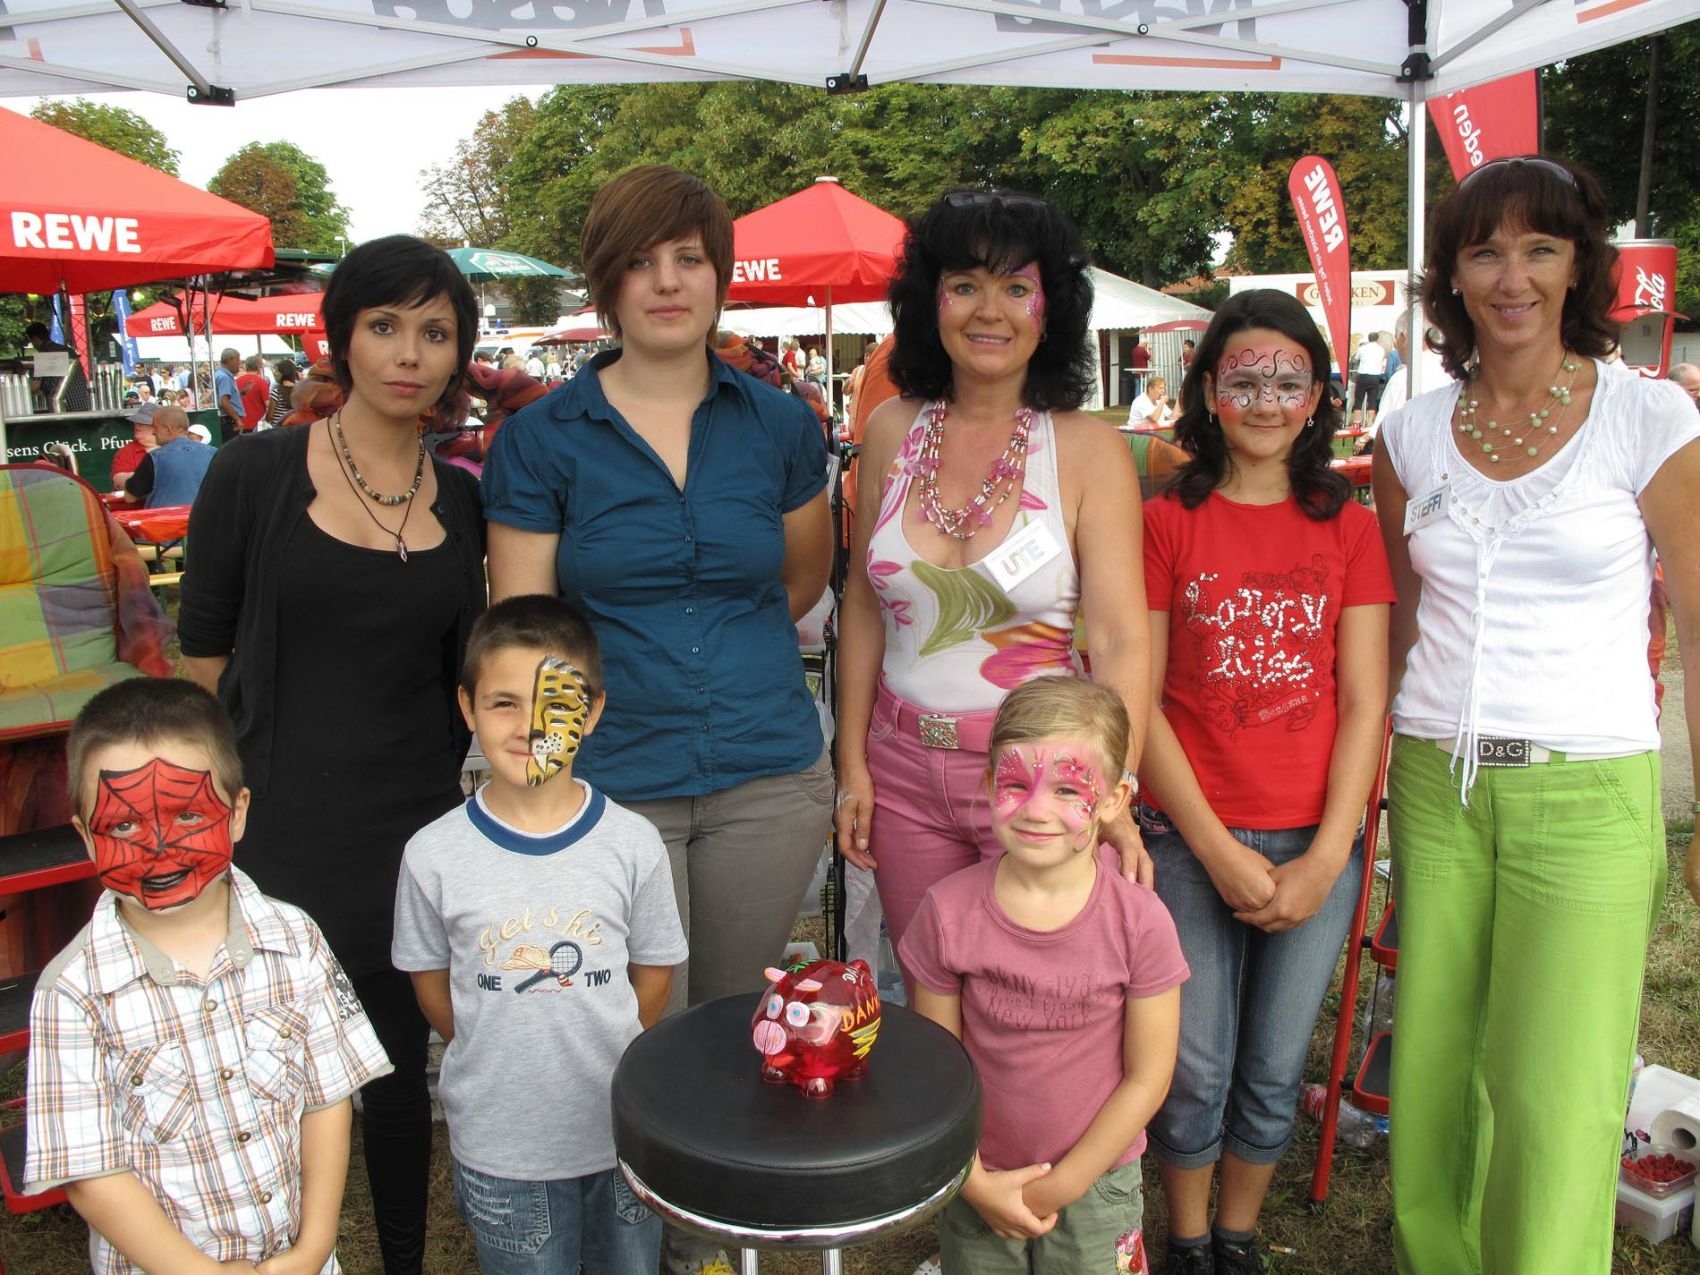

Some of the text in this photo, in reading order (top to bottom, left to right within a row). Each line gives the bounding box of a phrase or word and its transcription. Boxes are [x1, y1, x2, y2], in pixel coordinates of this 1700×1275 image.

[11, 211, 142, 253] REWE
[732, 258, 782, 283] EWE
[151, 316, 176, 332] REWE
[276, 313, 316, 327] REWE
[6, 445, 40, 458] sens
[1001, 538, 1045, 576] UTE
[1480, 741, 1523, 757] D&G
[477, 968, 611, 992] ONE TWO
